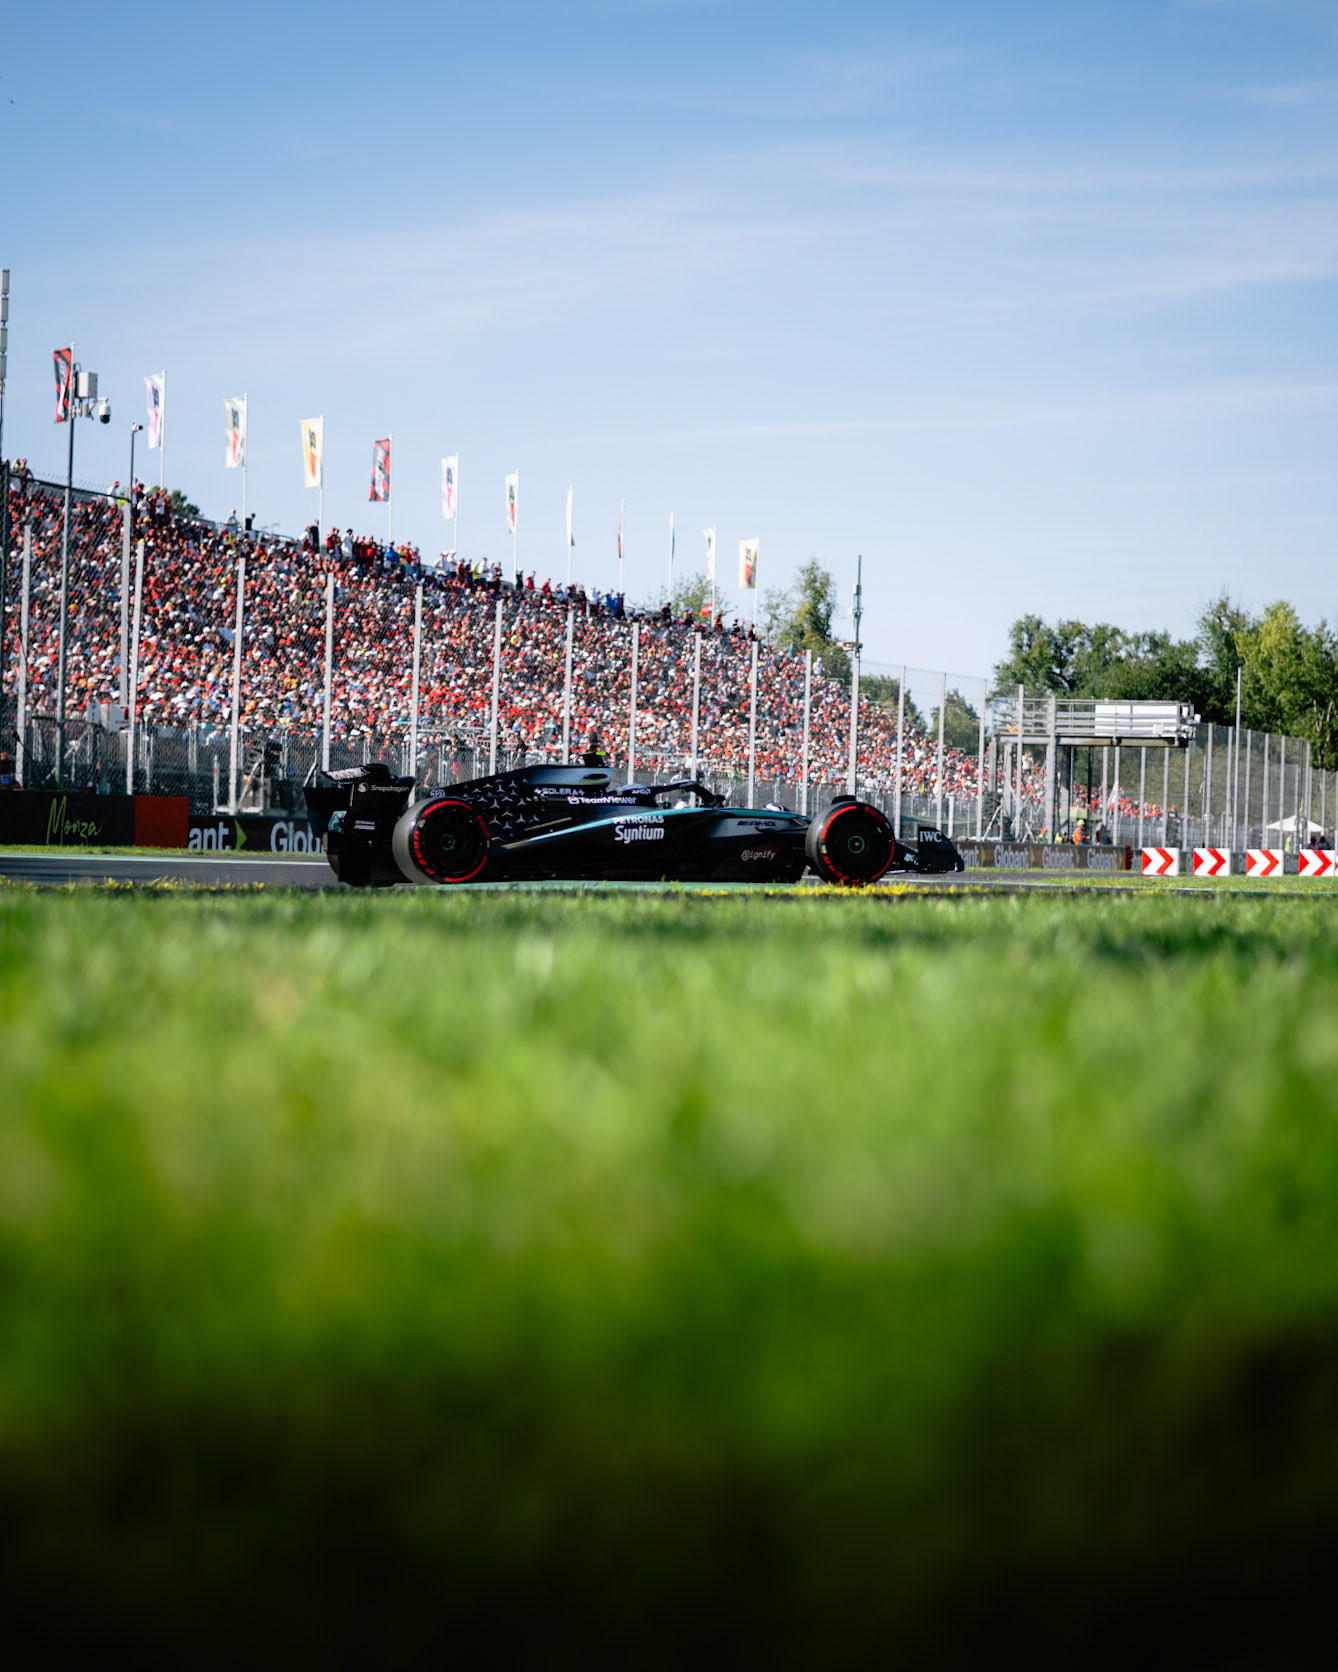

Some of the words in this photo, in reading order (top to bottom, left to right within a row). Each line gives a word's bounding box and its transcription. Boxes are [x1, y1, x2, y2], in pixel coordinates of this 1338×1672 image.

[369, 784, 410, 793] Snapdragon
[580, 796, 637, 804] TeamViewer
[46, 795, 103, 847] Monza
[613, 816, 665, 824] PETRONAS
[270, 821, 325, 854] Glob
[614, 825, 665, 844] Syntium
[919, 831, 943, 843] IWC
[957, 843, 980, 867] bant
[994, 844, 1029, 869] Globant
[1042, 846, 1075, 869] Globant
